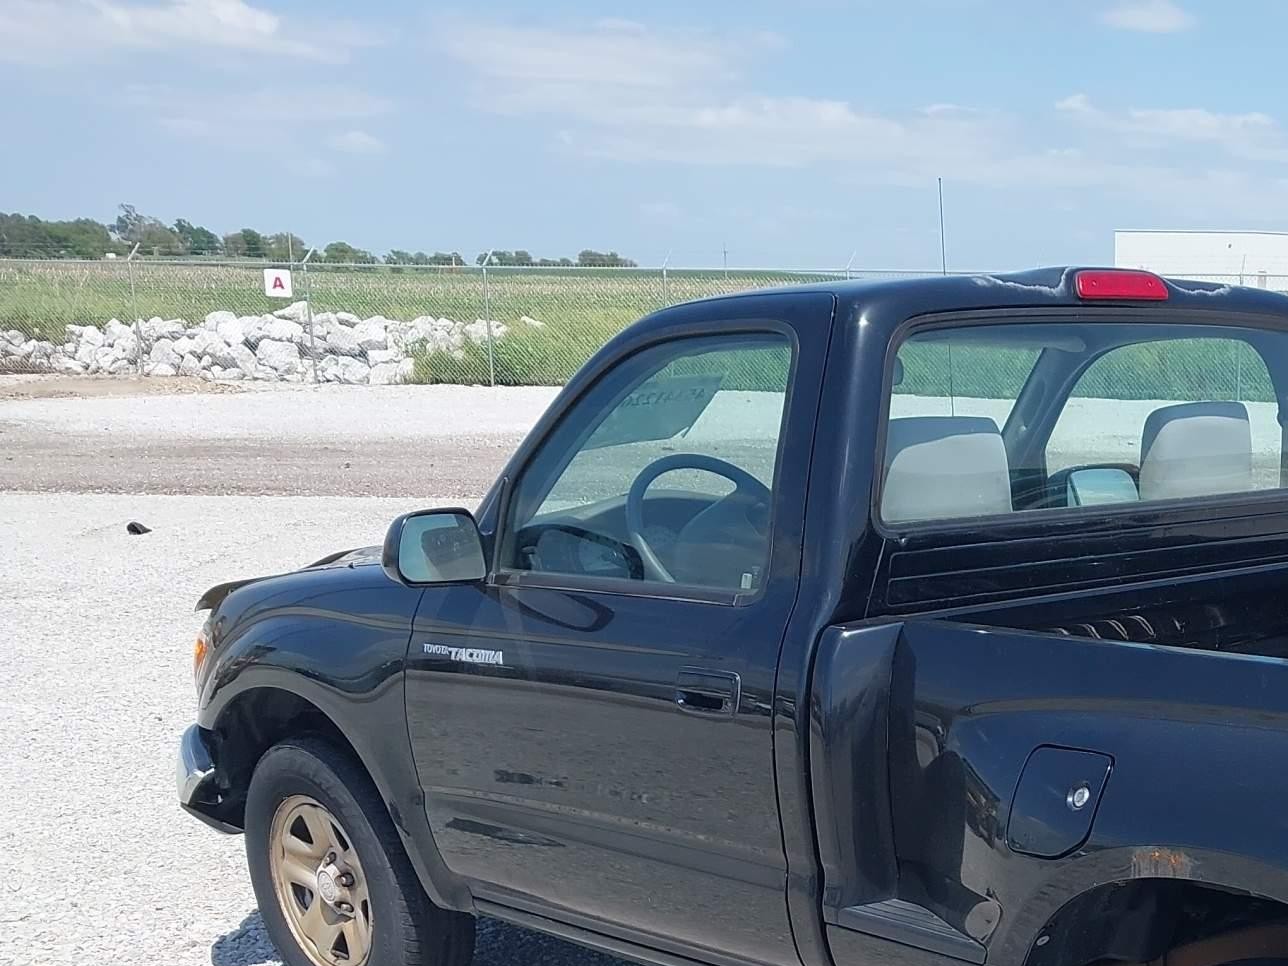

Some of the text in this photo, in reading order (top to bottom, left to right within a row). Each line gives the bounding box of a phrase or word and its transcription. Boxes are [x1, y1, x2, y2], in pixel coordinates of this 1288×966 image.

[272, 276, 285, 290] A
[423, 643, 504, 665] TOYOTA TACOMA
